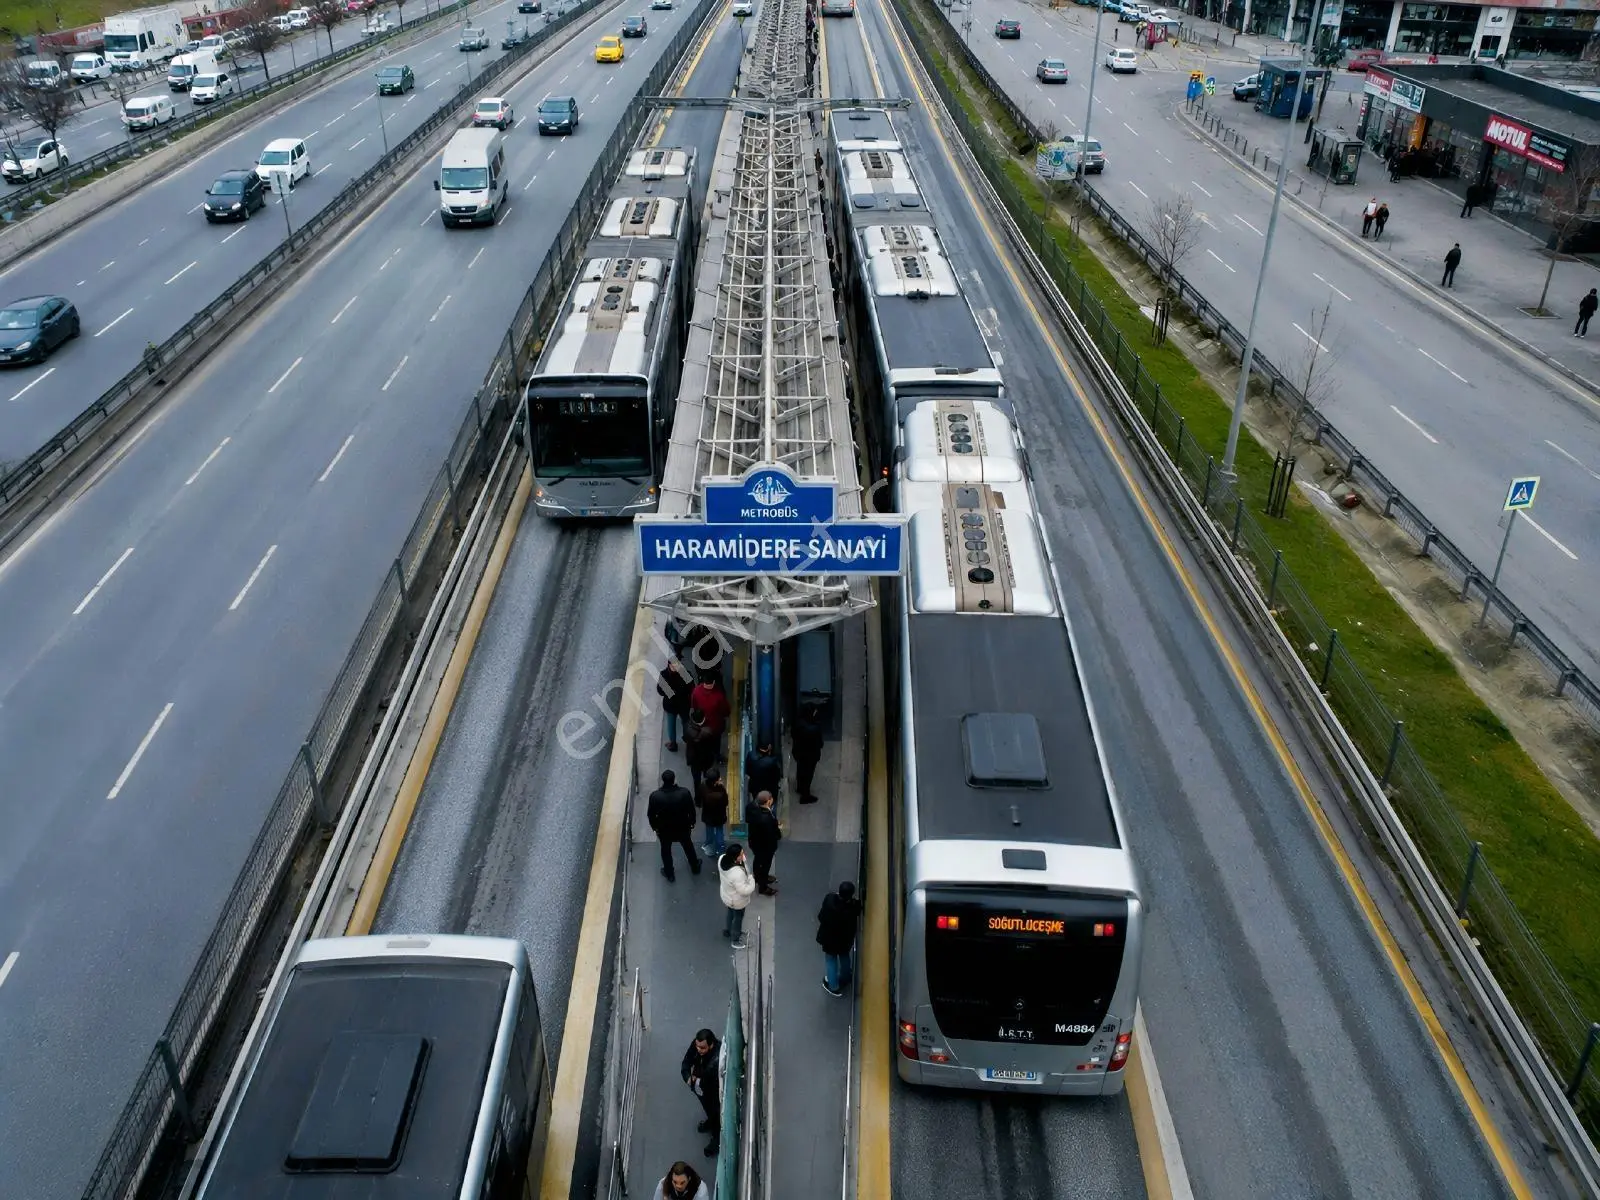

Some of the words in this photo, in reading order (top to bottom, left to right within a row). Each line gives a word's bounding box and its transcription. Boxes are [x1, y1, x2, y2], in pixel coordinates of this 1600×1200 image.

[1486, 119, 1527, 151] MOTUL
[655, 533, 800, 559] HARAMİDERE
[808, 533, 887, 559] SANAYİ
